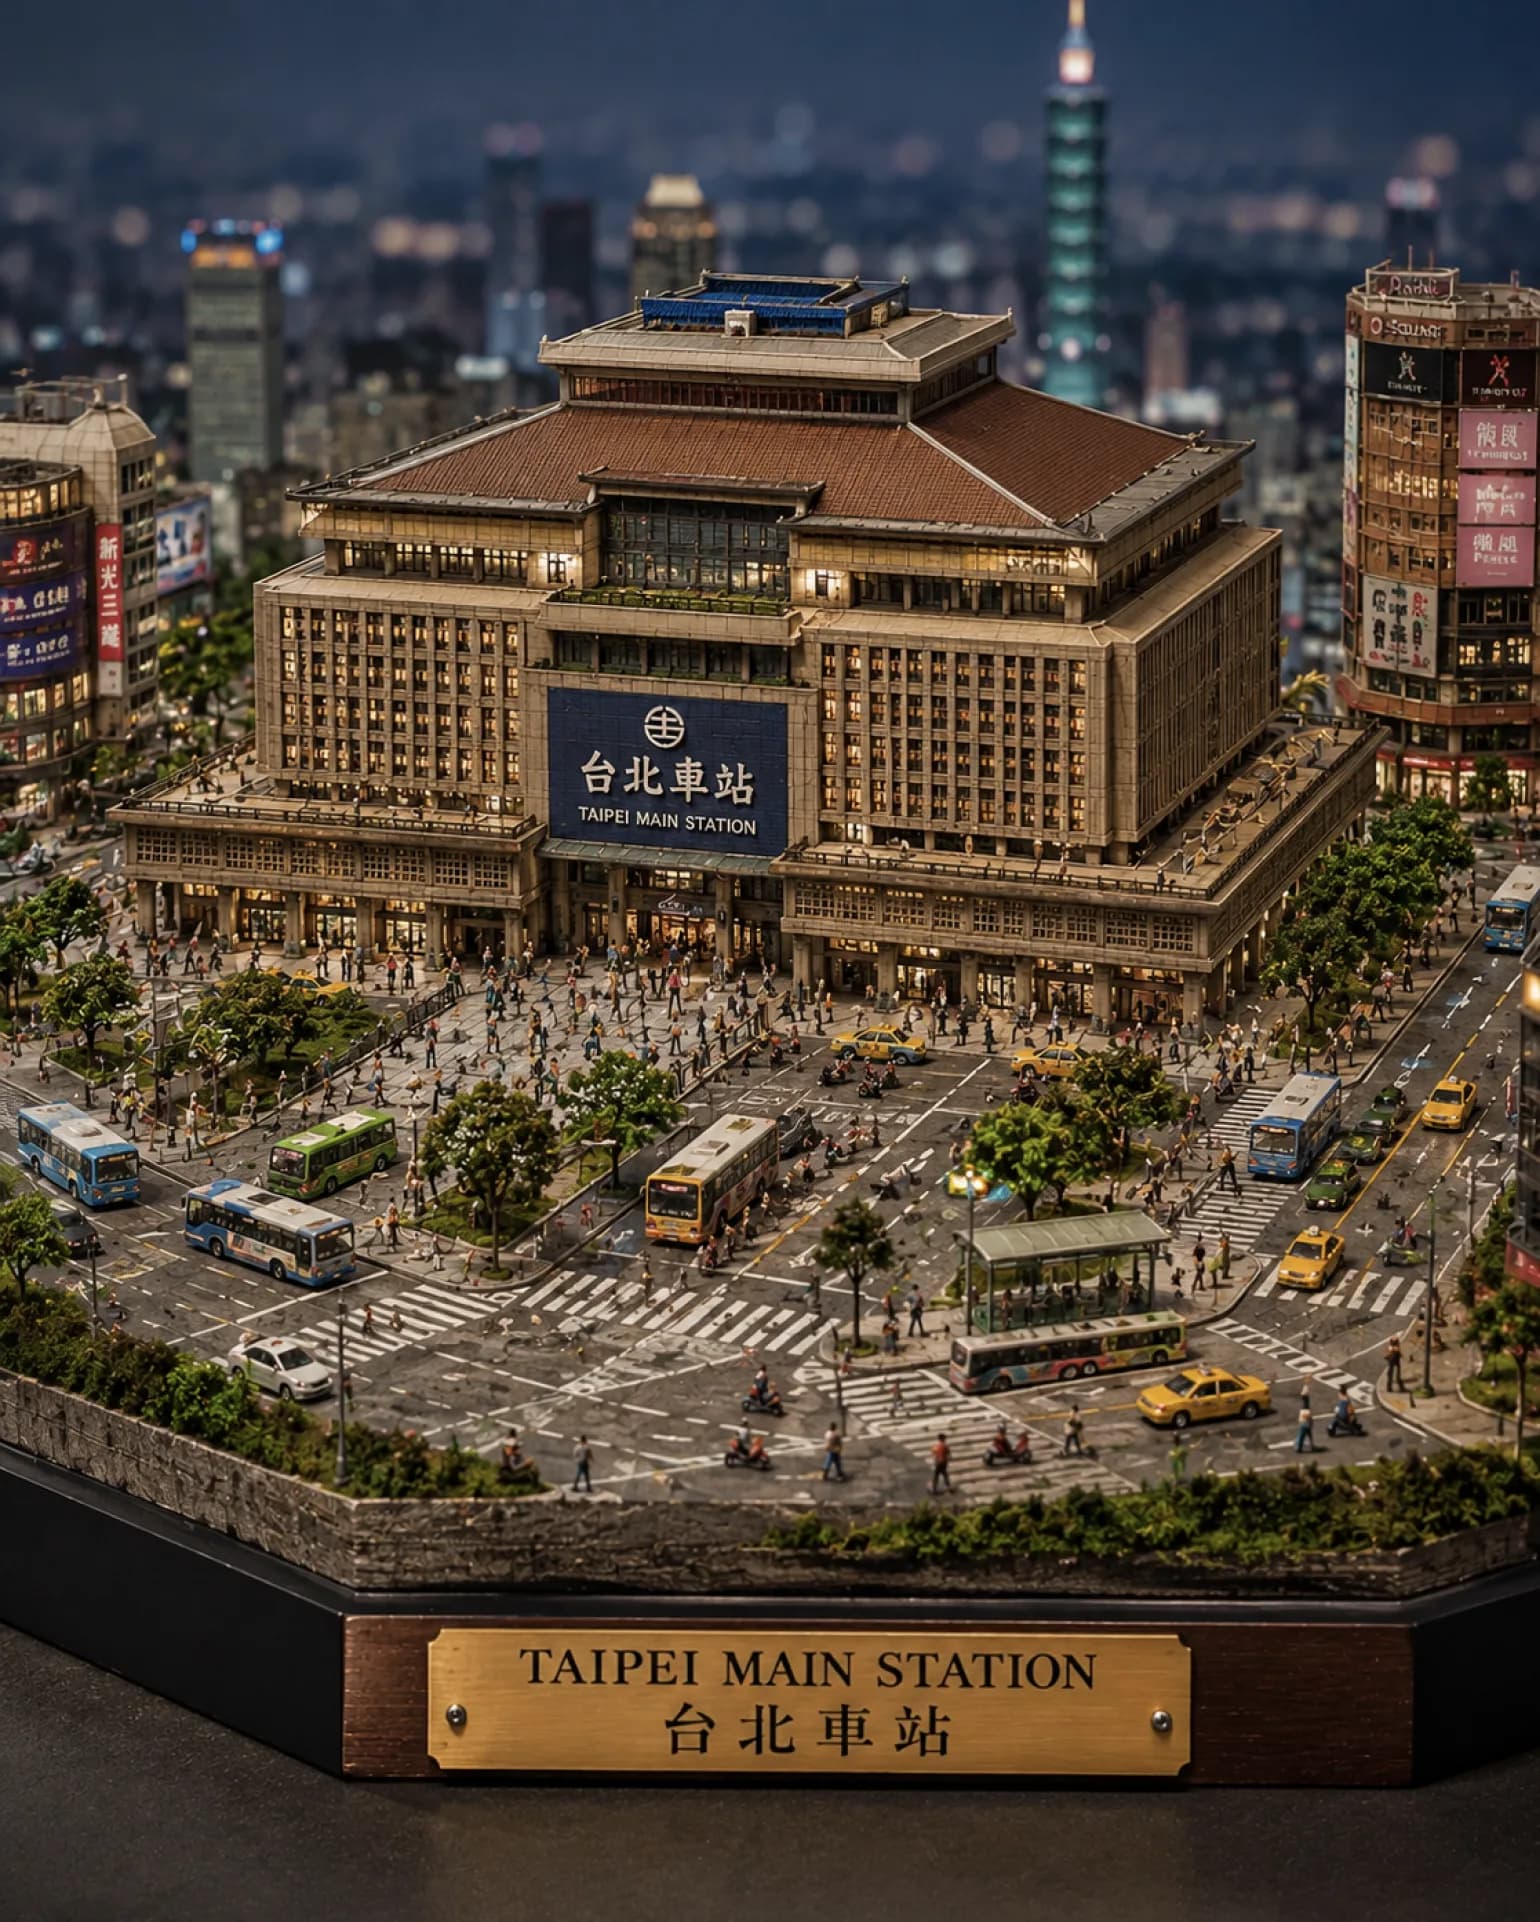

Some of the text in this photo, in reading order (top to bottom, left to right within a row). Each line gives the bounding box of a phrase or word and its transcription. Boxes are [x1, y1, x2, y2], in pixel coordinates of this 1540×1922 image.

[580, 750, 755, 805] 台北車站
[578, 805, 757, 836] TAIPEI MAIN STATION
[520, 1648, 1097, 1690] TAIPEI MAIN STATION
[664, 1702, 952, 1757] 台北車站
